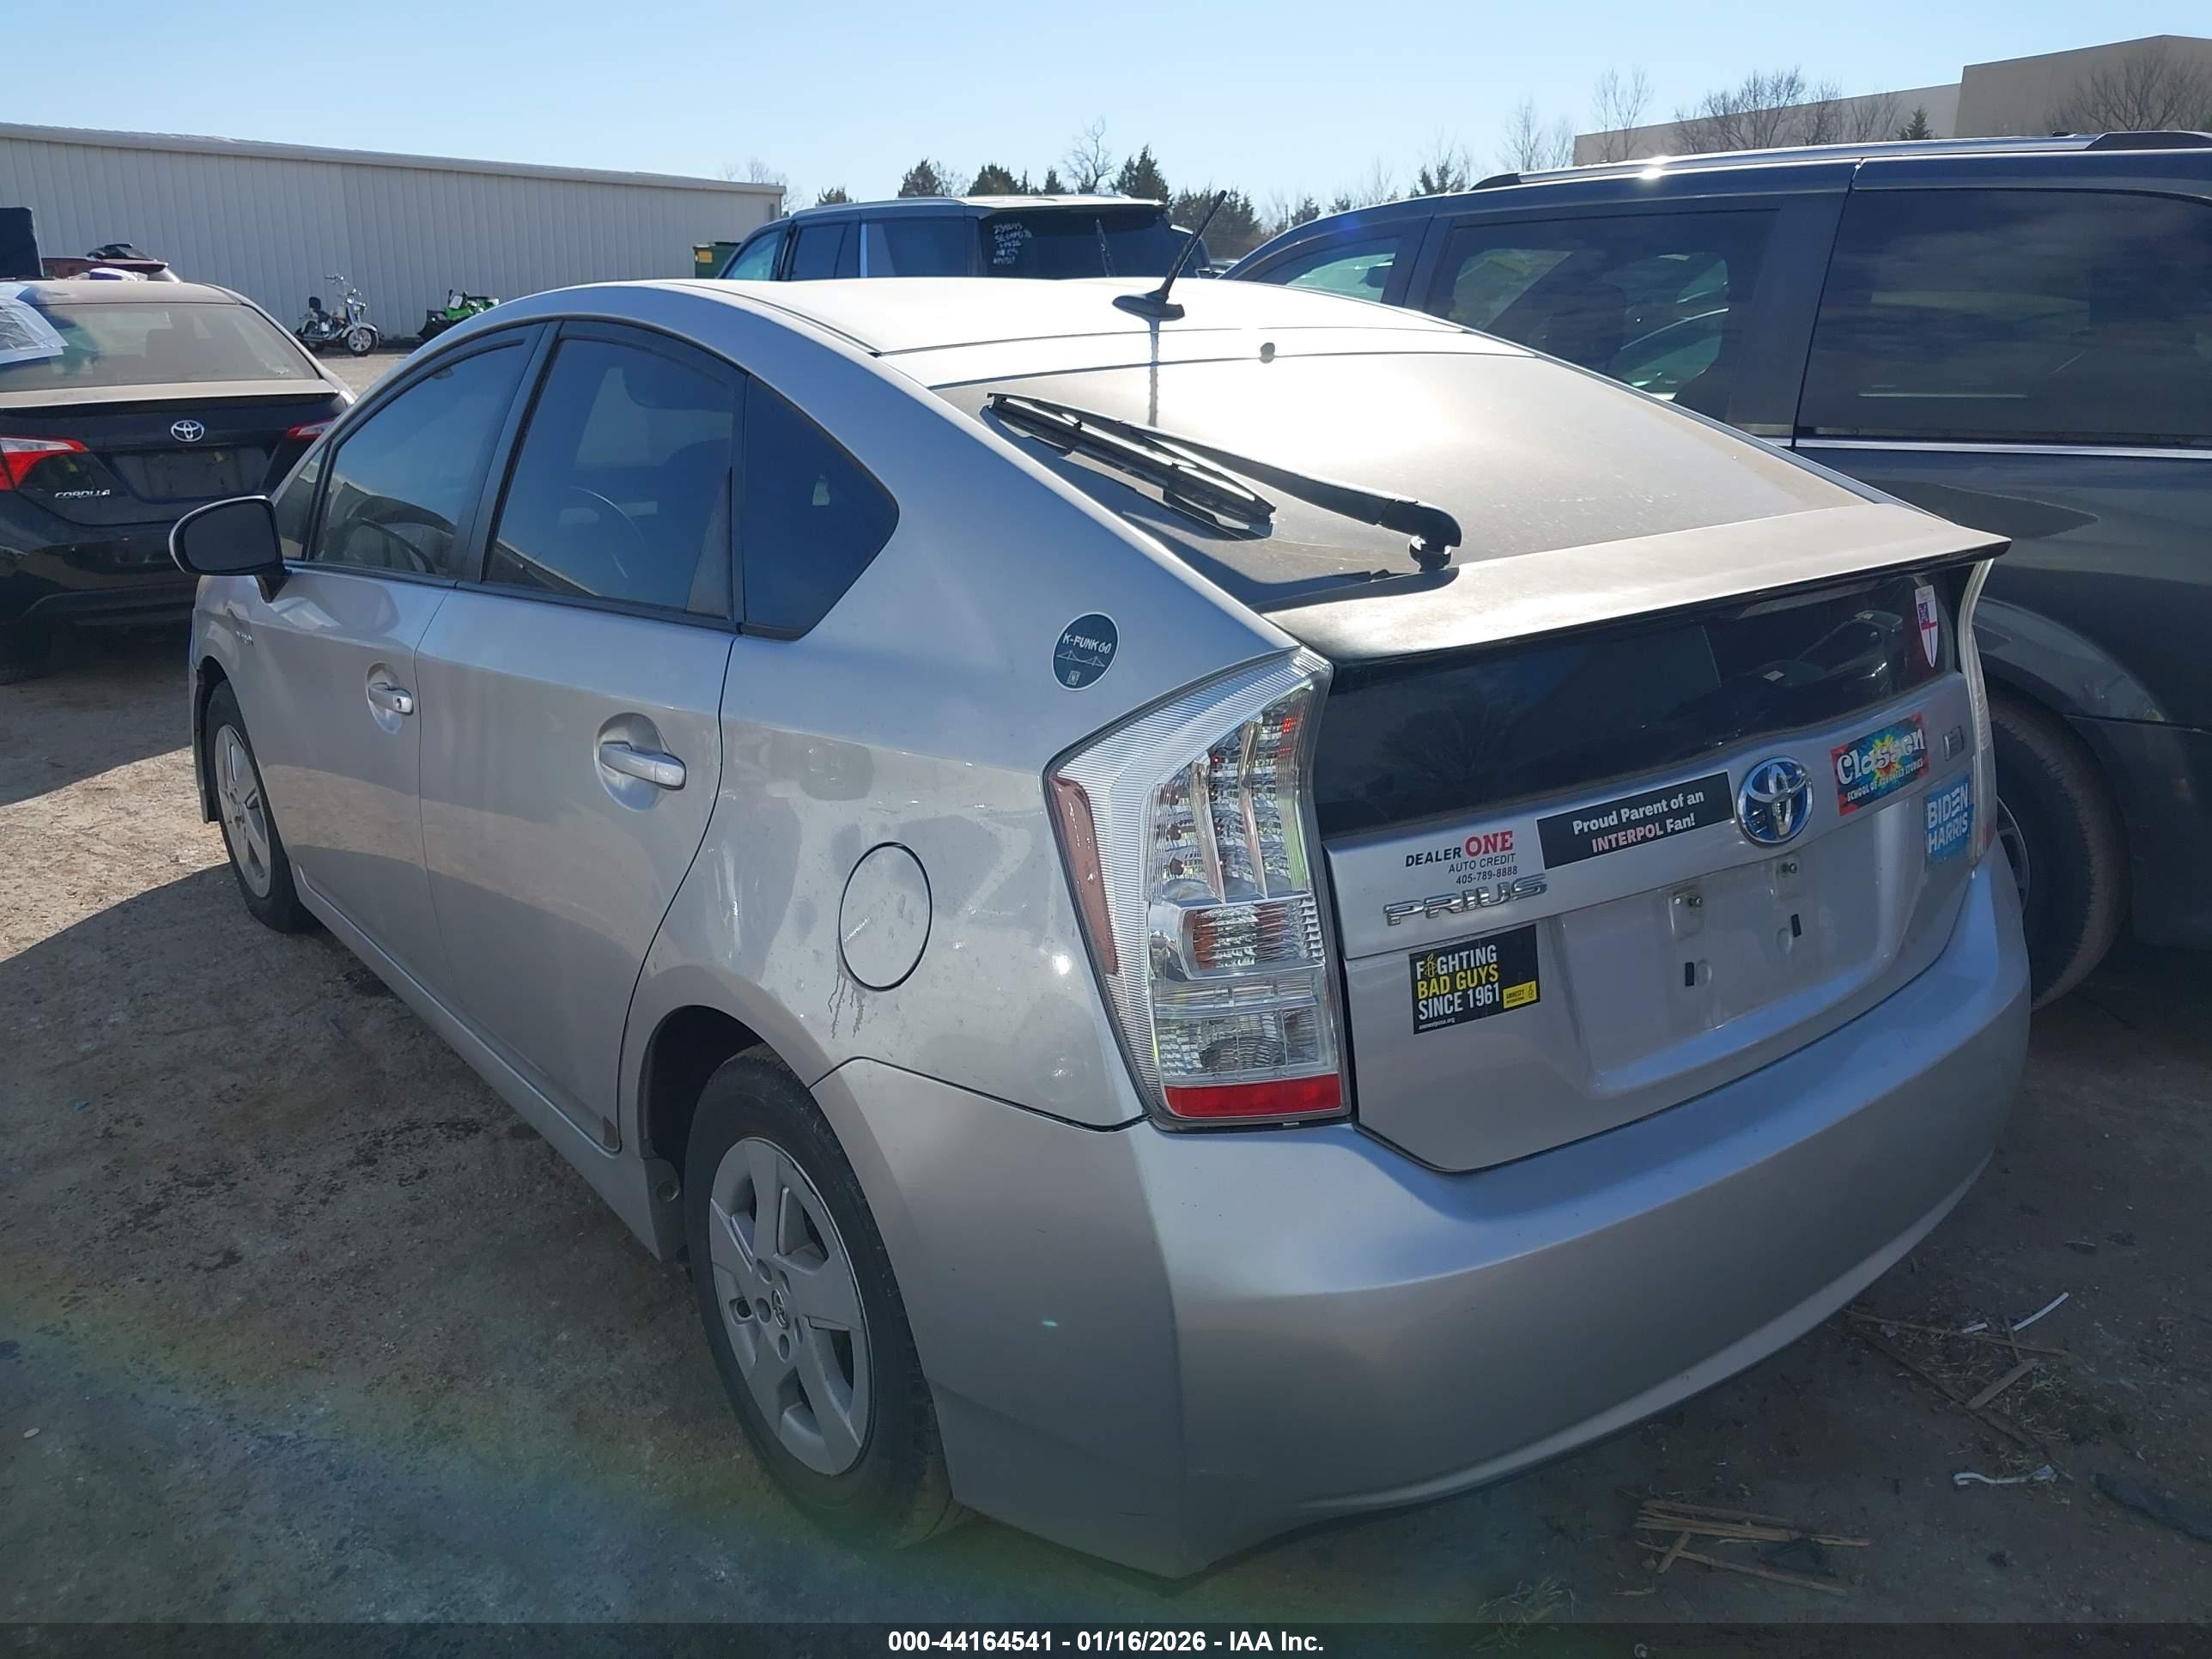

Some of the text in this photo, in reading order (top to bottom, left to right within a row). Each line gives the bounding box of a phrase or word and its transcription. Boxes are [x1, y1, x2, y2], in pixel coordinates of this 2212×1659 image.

[1062, 632, 1100, 652] K-FUNK
[1836, 727, 1925, 785] Classen
[1847, 784, 1869, 802] SCHOOL
[1927, 782, 1969, 830] BIDEN
[1572, 791, 1705, 836] Proud Parent of an
[1591, 812, 1696, 853] INTERPOL Fan!
[1928, 811, 1968, 854] HARRIS
[1406, 830, 1514, 867] DEALER ONE
[1448, 853, 1516, 874] AUTO CREDIT
[1455, 865, 1518, 885] 405-789-8888
[1382, 872, 1547, 927] PRIUS
[1417, 963, 1499, 1000] BAD GUYS
[1418, 981, 1500, 1020] SINCE 1961
